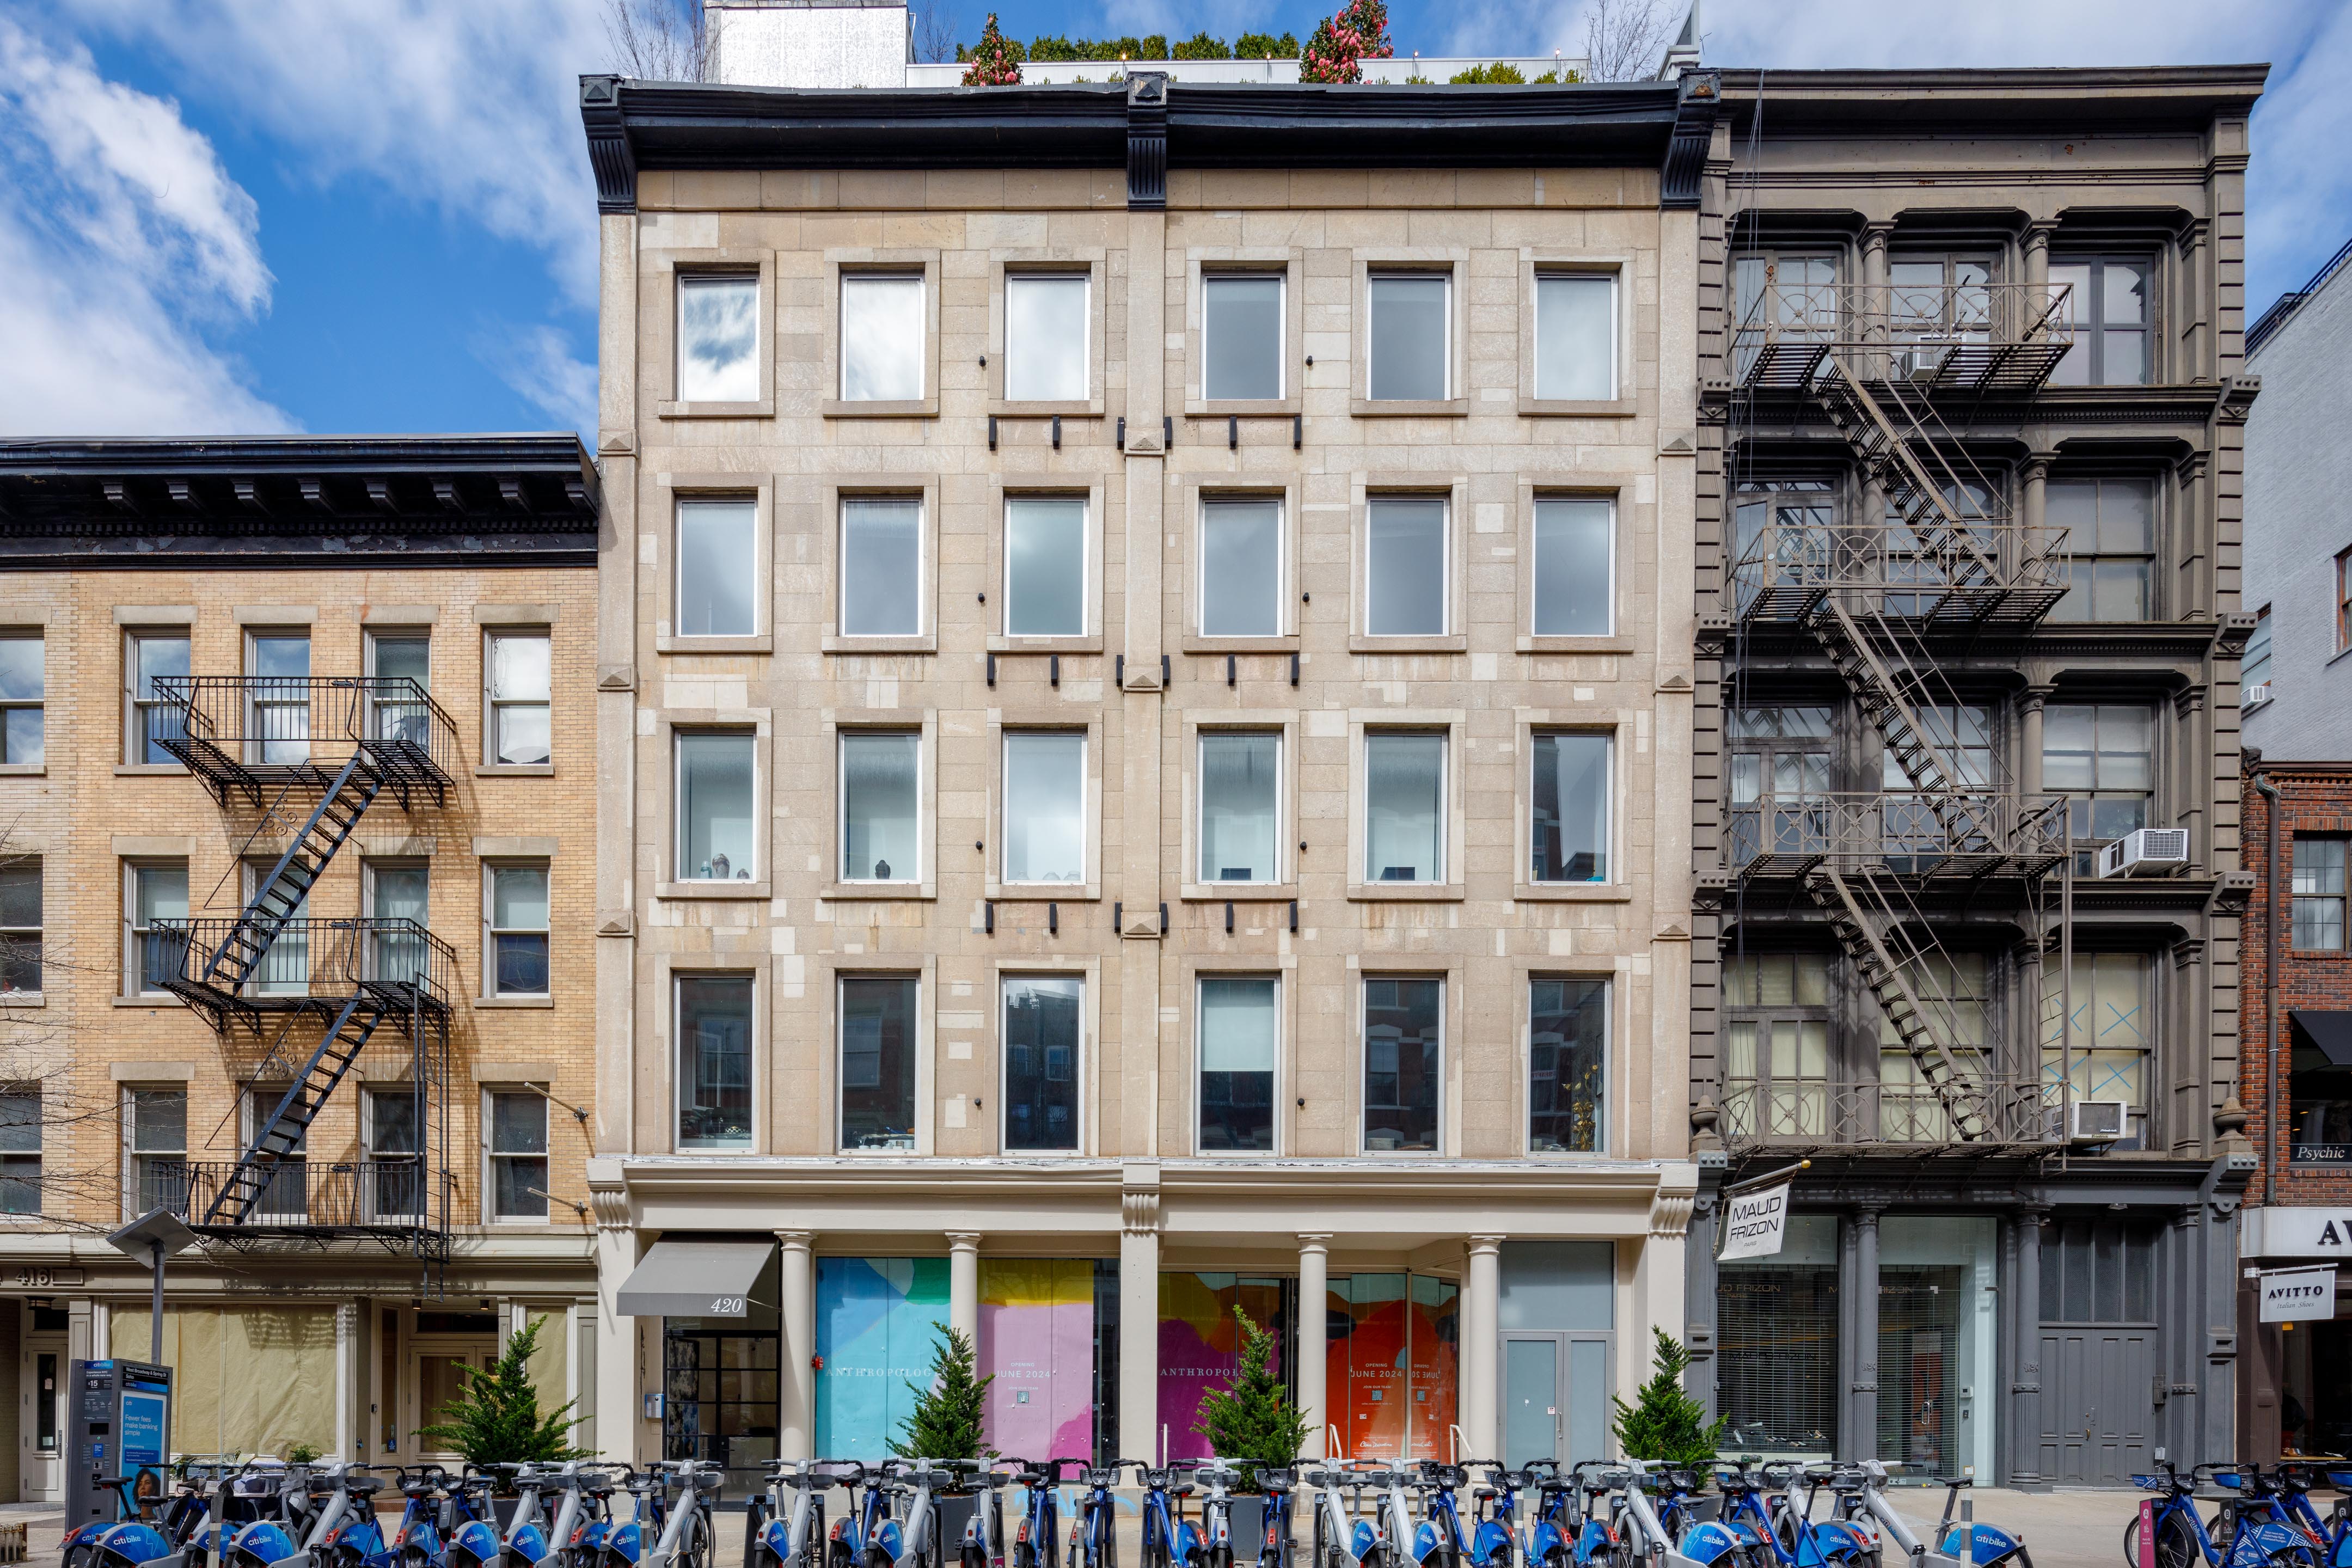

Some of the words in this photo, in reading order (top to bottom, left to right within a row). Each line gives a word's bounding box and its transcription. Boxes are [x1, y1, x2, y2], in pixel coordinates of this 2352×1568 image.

[2296, 1146, 2345, 1161] Psychic
[1732, 1196, 1781, 1222] MAUD
[1730, 1217, 1779, 1241] FRIZON
[15, 1267, 48, 1284] 416
[1736, 1284, 1781, 1293] FRIZON
[2268, 1285, 2323, 1298] AVITTO
[710, 1298, 742, 1313] 420
[1026, 1370, 1050, 1378] 2024
